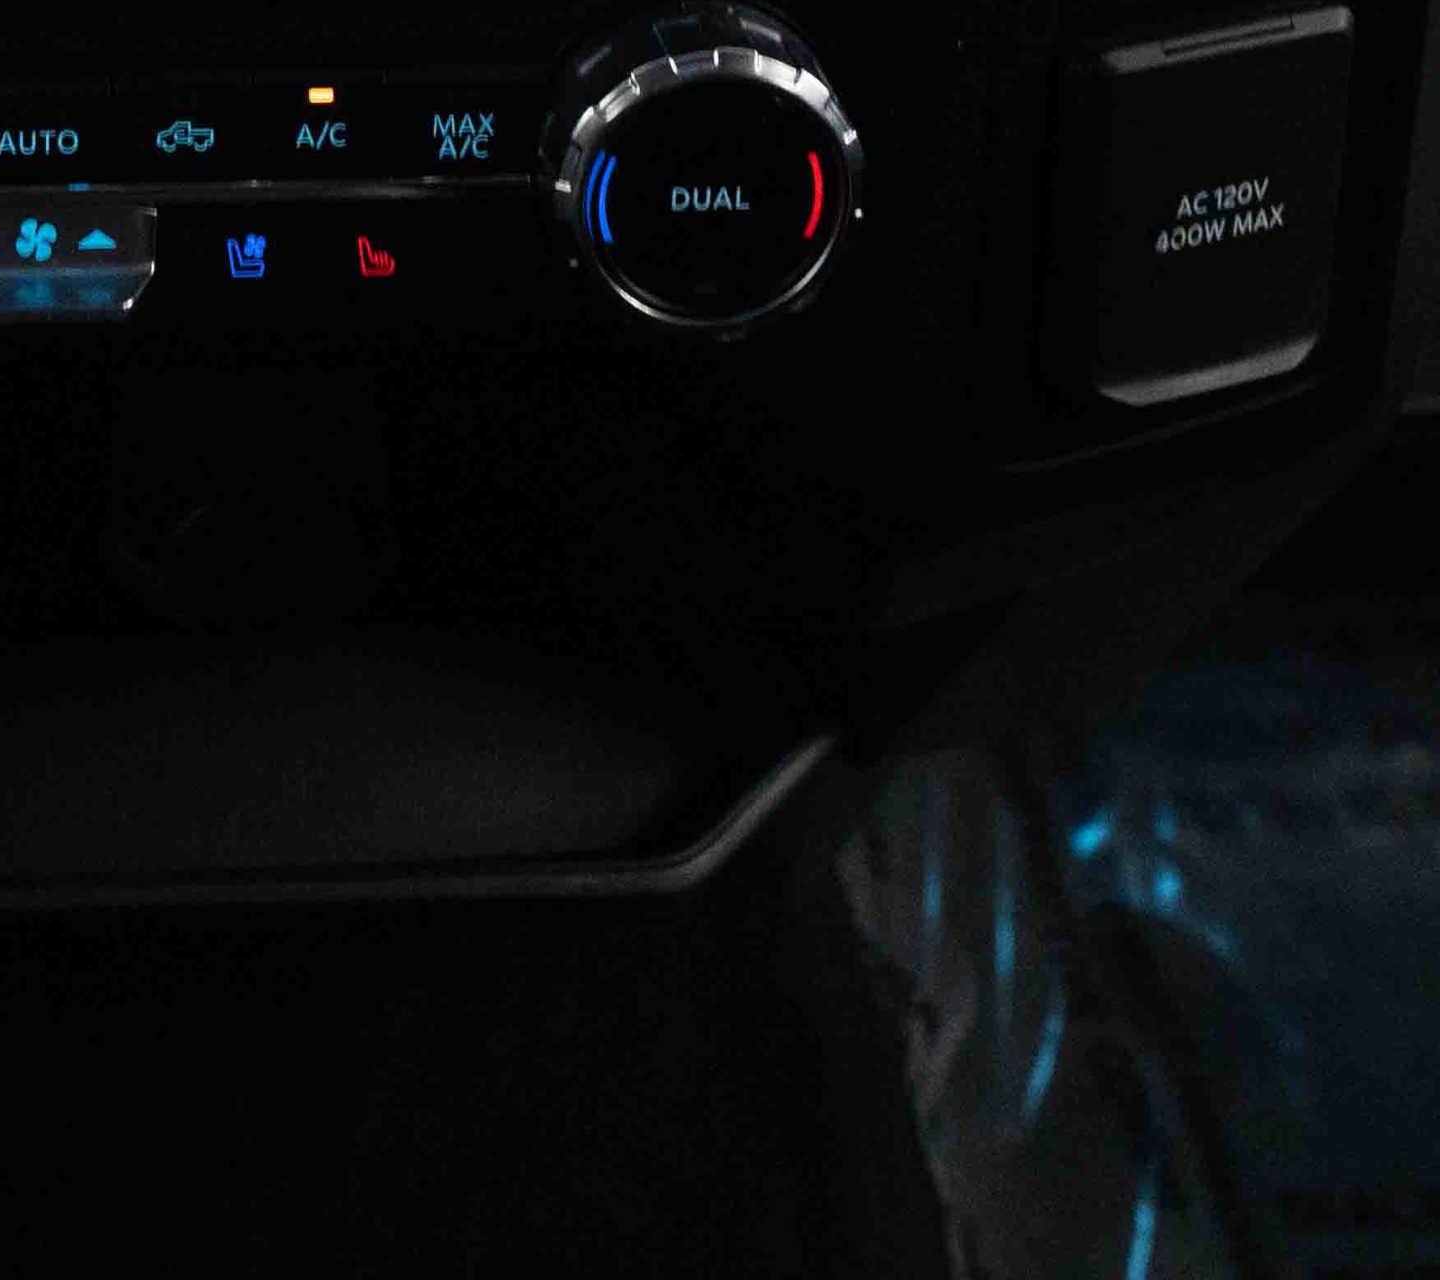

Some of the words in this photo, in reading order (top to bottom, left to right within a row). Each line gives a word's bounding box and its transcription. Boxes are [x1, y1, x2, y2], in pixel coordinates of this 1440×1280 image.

[296, 121, 347, 150] A/C
[433, 113, 495, 137] MAX
[440, 134, 490, 162] A/C
[671, 185, 751, 212] DUAL
[1176, 190, 1210, 220] AC
[1213, 176, 1270, 211] 120V
[1155, 216, 1226, 254] 400W
[1232, 202, 1285, 238] MAX
